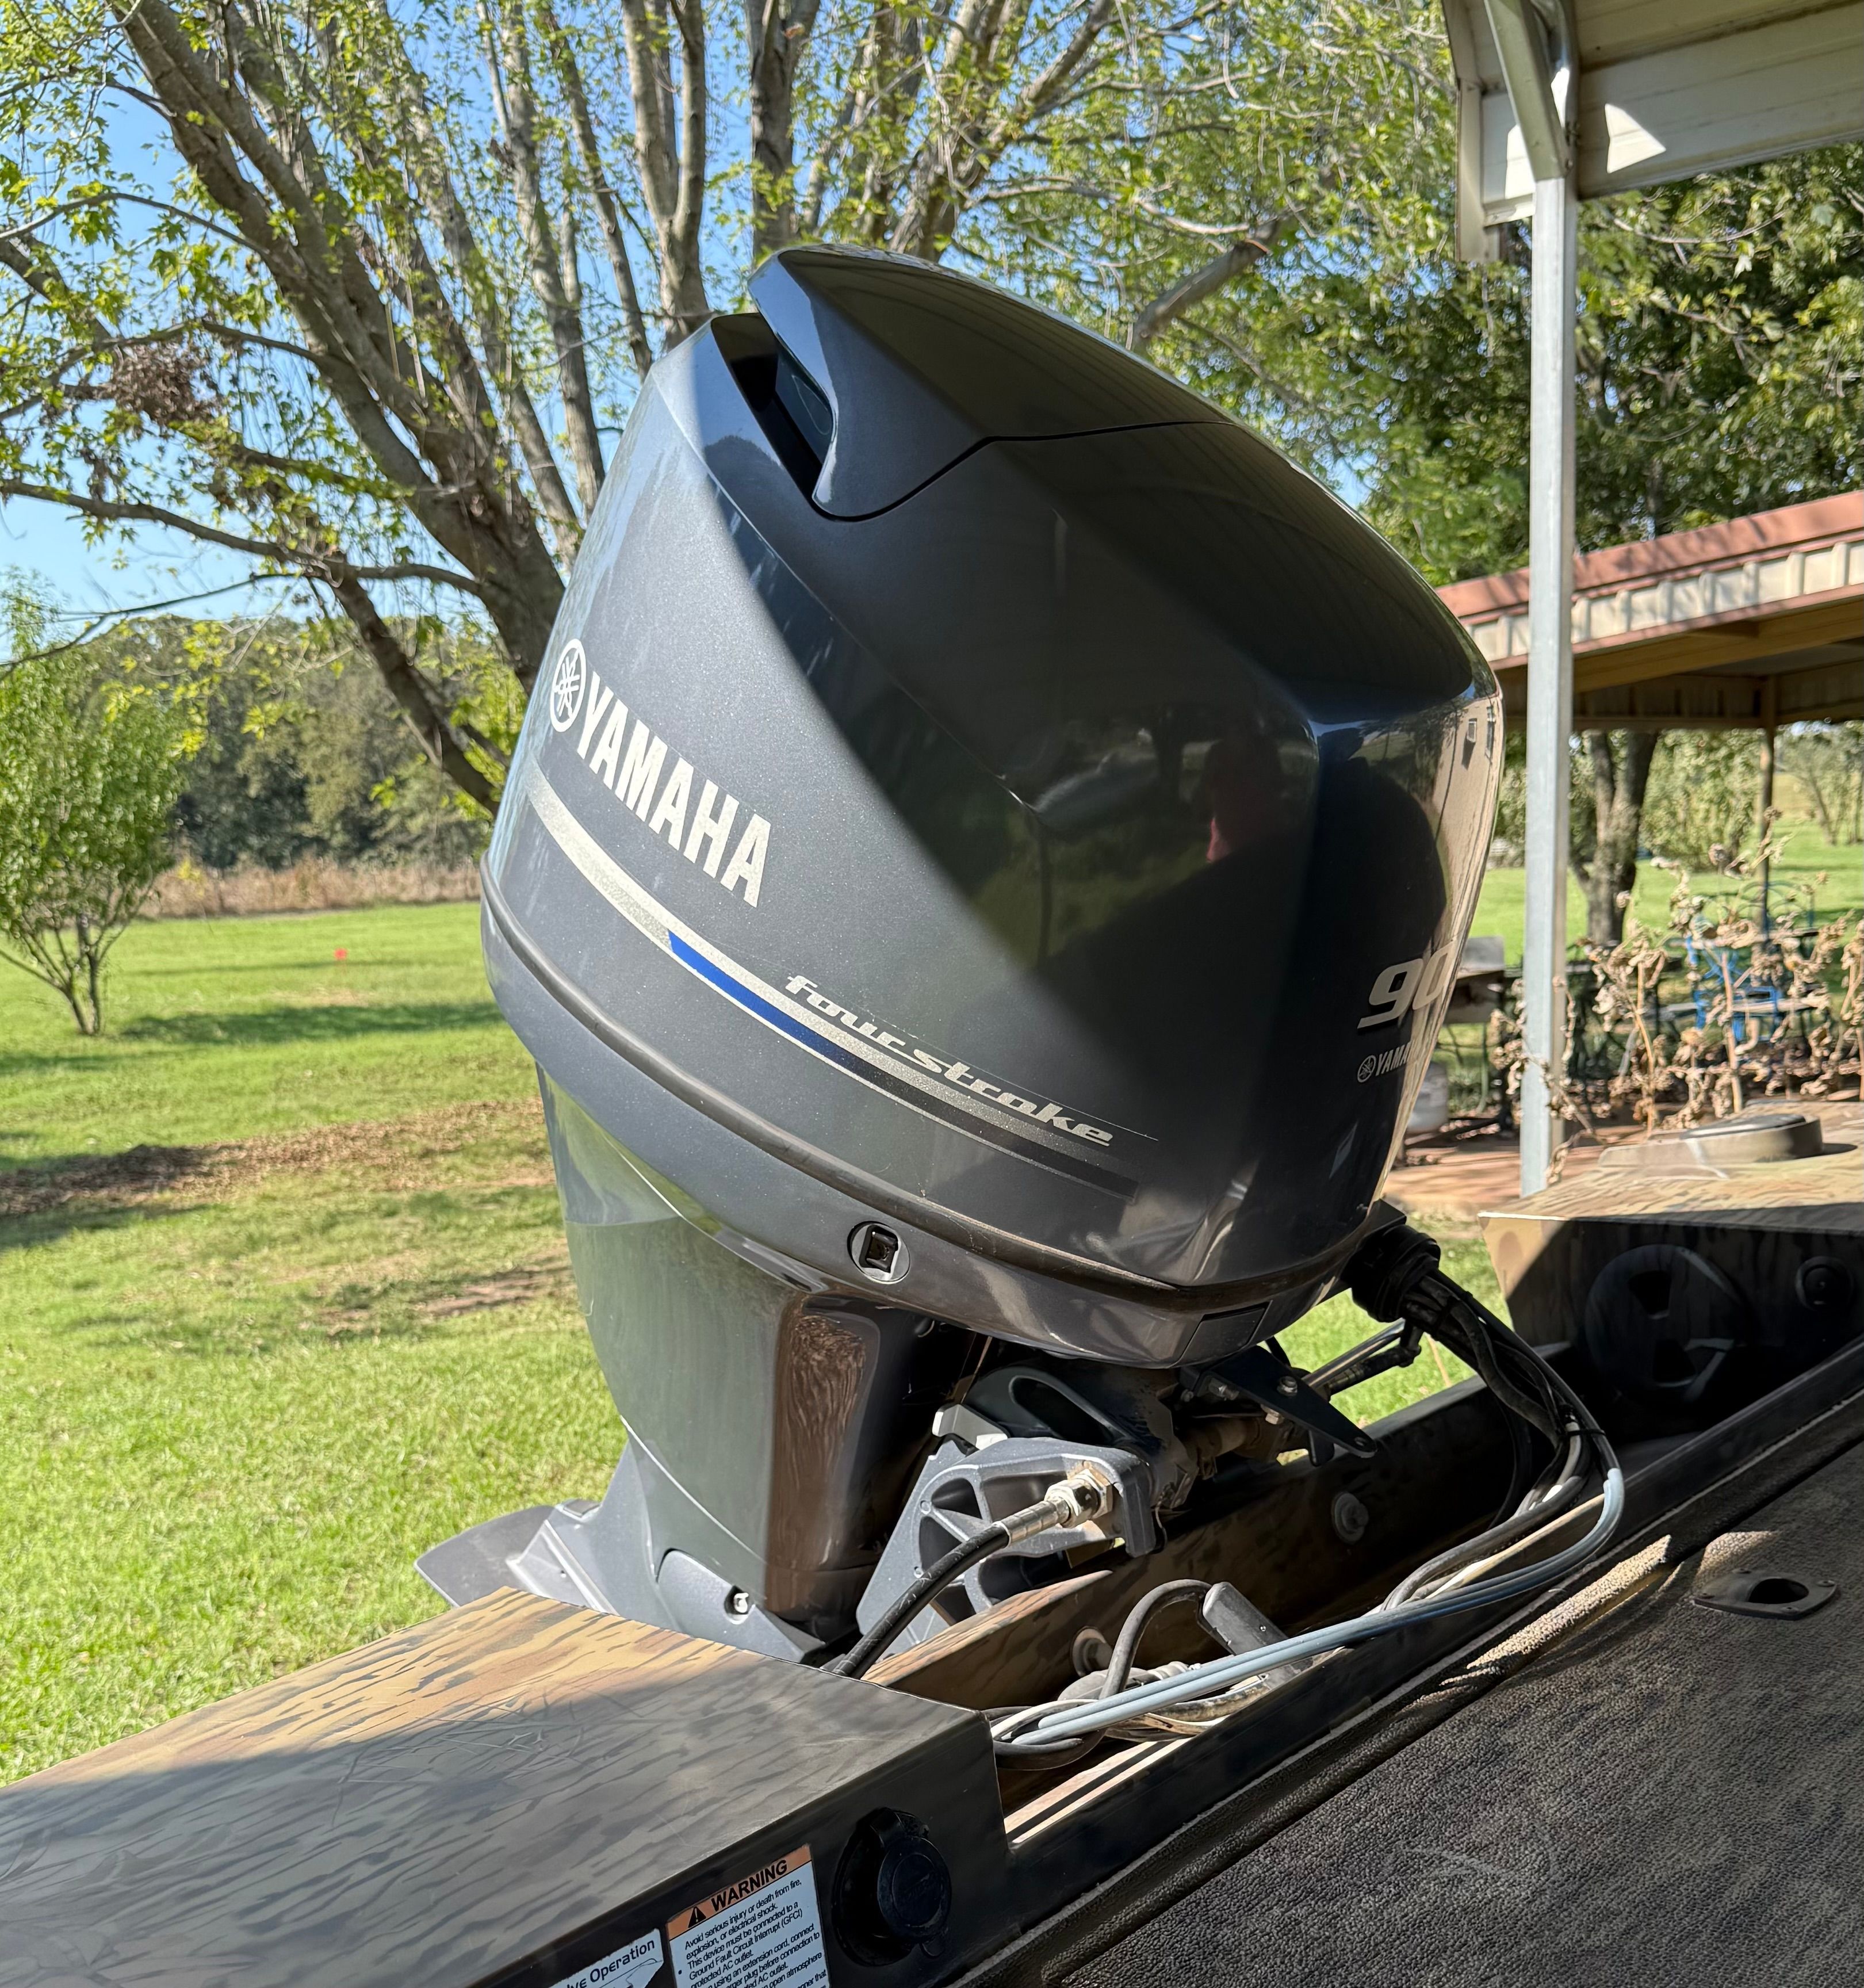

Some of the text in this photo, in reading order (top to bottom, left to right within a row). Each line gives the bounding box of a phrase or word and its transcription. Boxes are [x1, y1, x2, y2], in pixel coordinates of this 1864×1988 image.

[577, 671, 771, 908] YAMAHA
[1357, 941, 1455, 1029] 90
[711, 1860, 787, 1911] WARNING
[685, 1879, 802, 1951] Avoid serious injury or death from fire,
[686, 1937, 719, 1960] explosion,
[720, 1932, 728, 1940] or
[728, 1913, 757, 1936] electrical
[687, 1957, 703, 1970] This
[703, 1945, 725, 1961] device
[726, 1933, 742, 1948] must
[743, 1929, 752, 1939] be
[753, 1907, 786, 1933] connected
[590, 1940, 655, 1983] Operation
[690, 1908, 802, 1980] Ground Fault Circuit Interrupt (GFCI)
[714, 1974, 732, 1988] using
[733, 1968, 742, 1978] an
[742, 1949, 773, 1971] extension
[790, 1923, 814, 1943] connect
[722, 1960, 734, 1973] AC
[744, 1969, 759, 1984] plug
[759, 1956, 779, 1972] before
[780, 1936, 813, 1960] connection
[813, 1932, 820, 1940] to
[758, 1972, 769, 1985] AC
[769, 1952, 822, 1988] open atmosphere
[814, 1970, 826, 1982] that
